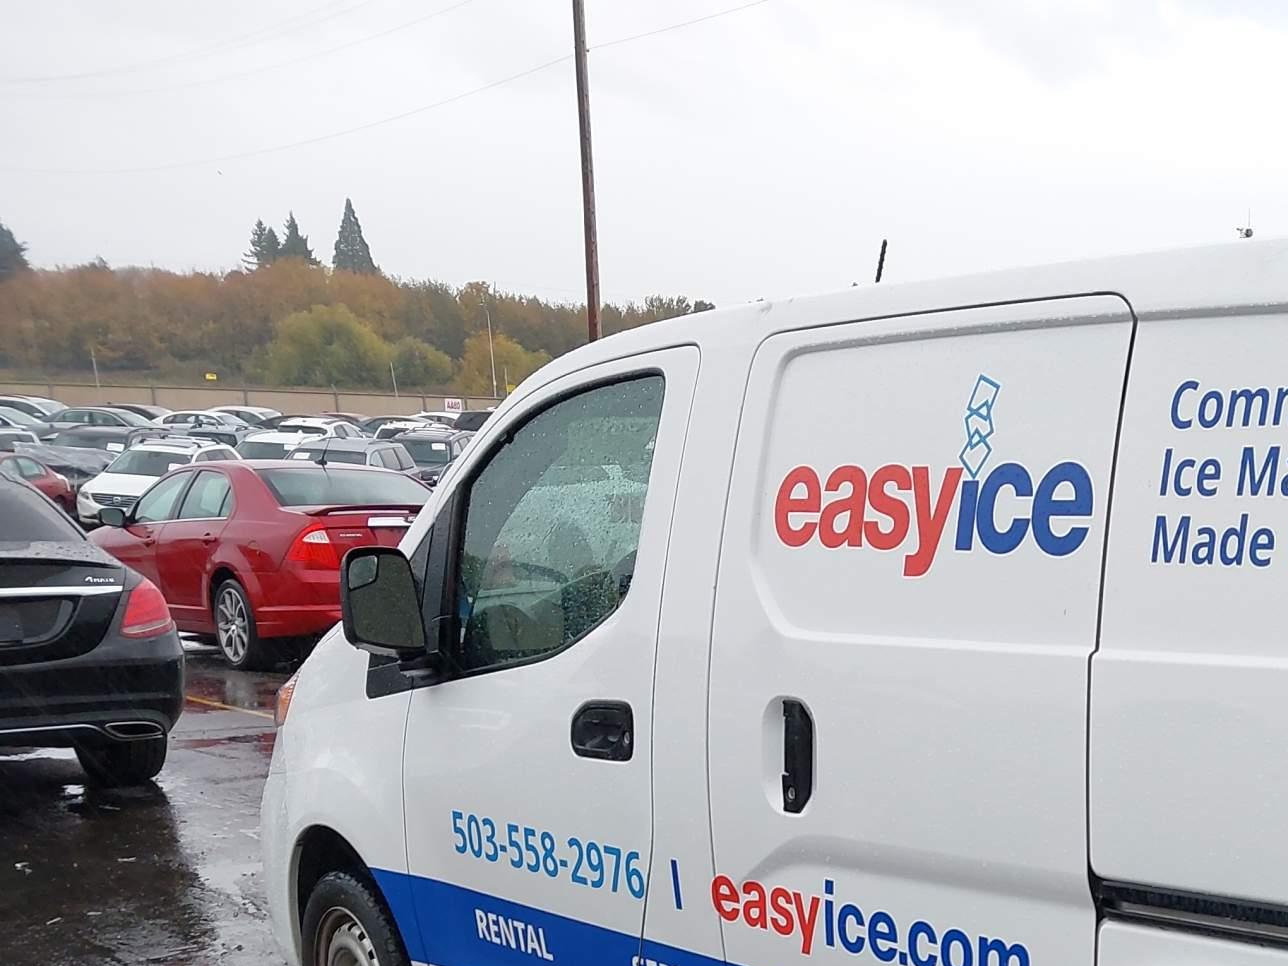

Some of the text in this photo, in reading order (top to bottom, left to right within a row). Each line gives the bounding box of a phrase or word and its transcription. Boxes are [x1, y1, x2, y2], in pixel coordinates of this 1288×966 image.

[1159, 448, 1222, 497] Ice
[774, 460, 1095, 578] easyice
[1150, 513, 1276, 567] Made
[451, 809, 646, 900] 503-558-2976
[474, 908, 554, 962] RENTAL
